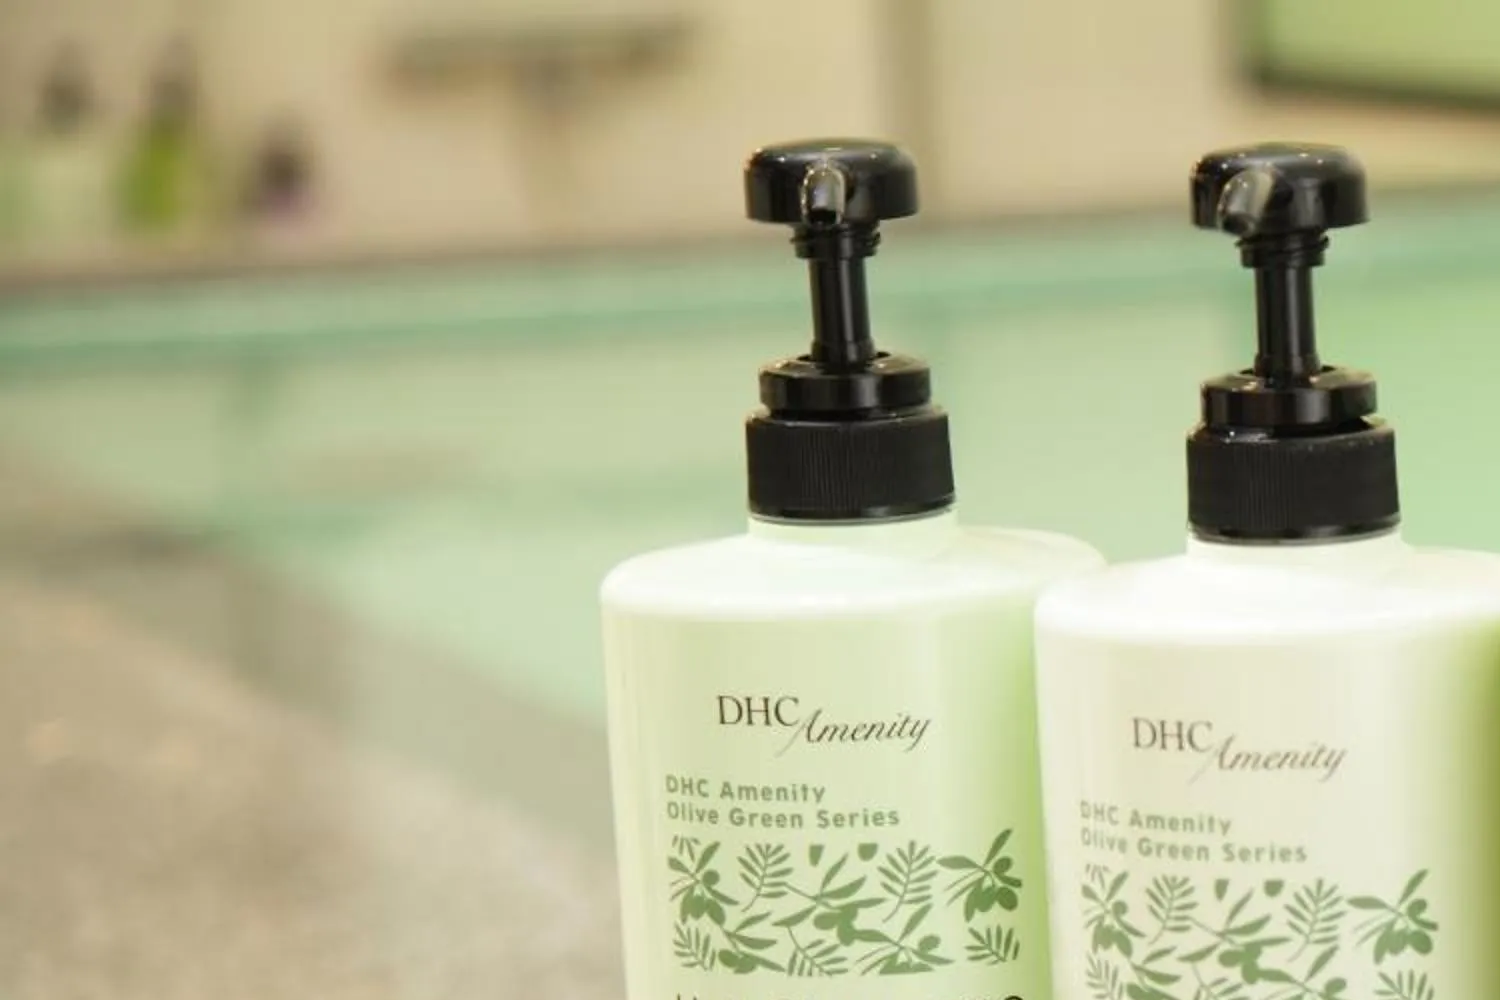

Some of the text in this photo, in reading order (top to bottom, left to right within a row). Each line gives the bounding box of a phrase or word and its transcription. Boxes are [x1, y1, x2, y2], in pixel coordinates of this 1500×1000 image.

[717, 695, 931, 758] DHC Amenity
[1132, 717, 1347, 785] DHC Amenity
[665, 774, 826, 803] DHC Amenity
[667, 801, 900, 828] Olive Green Series
[1081, 801, 1232, 836] DHC Amenity
[1081, 827, 1307, 863] Olive Green Series
